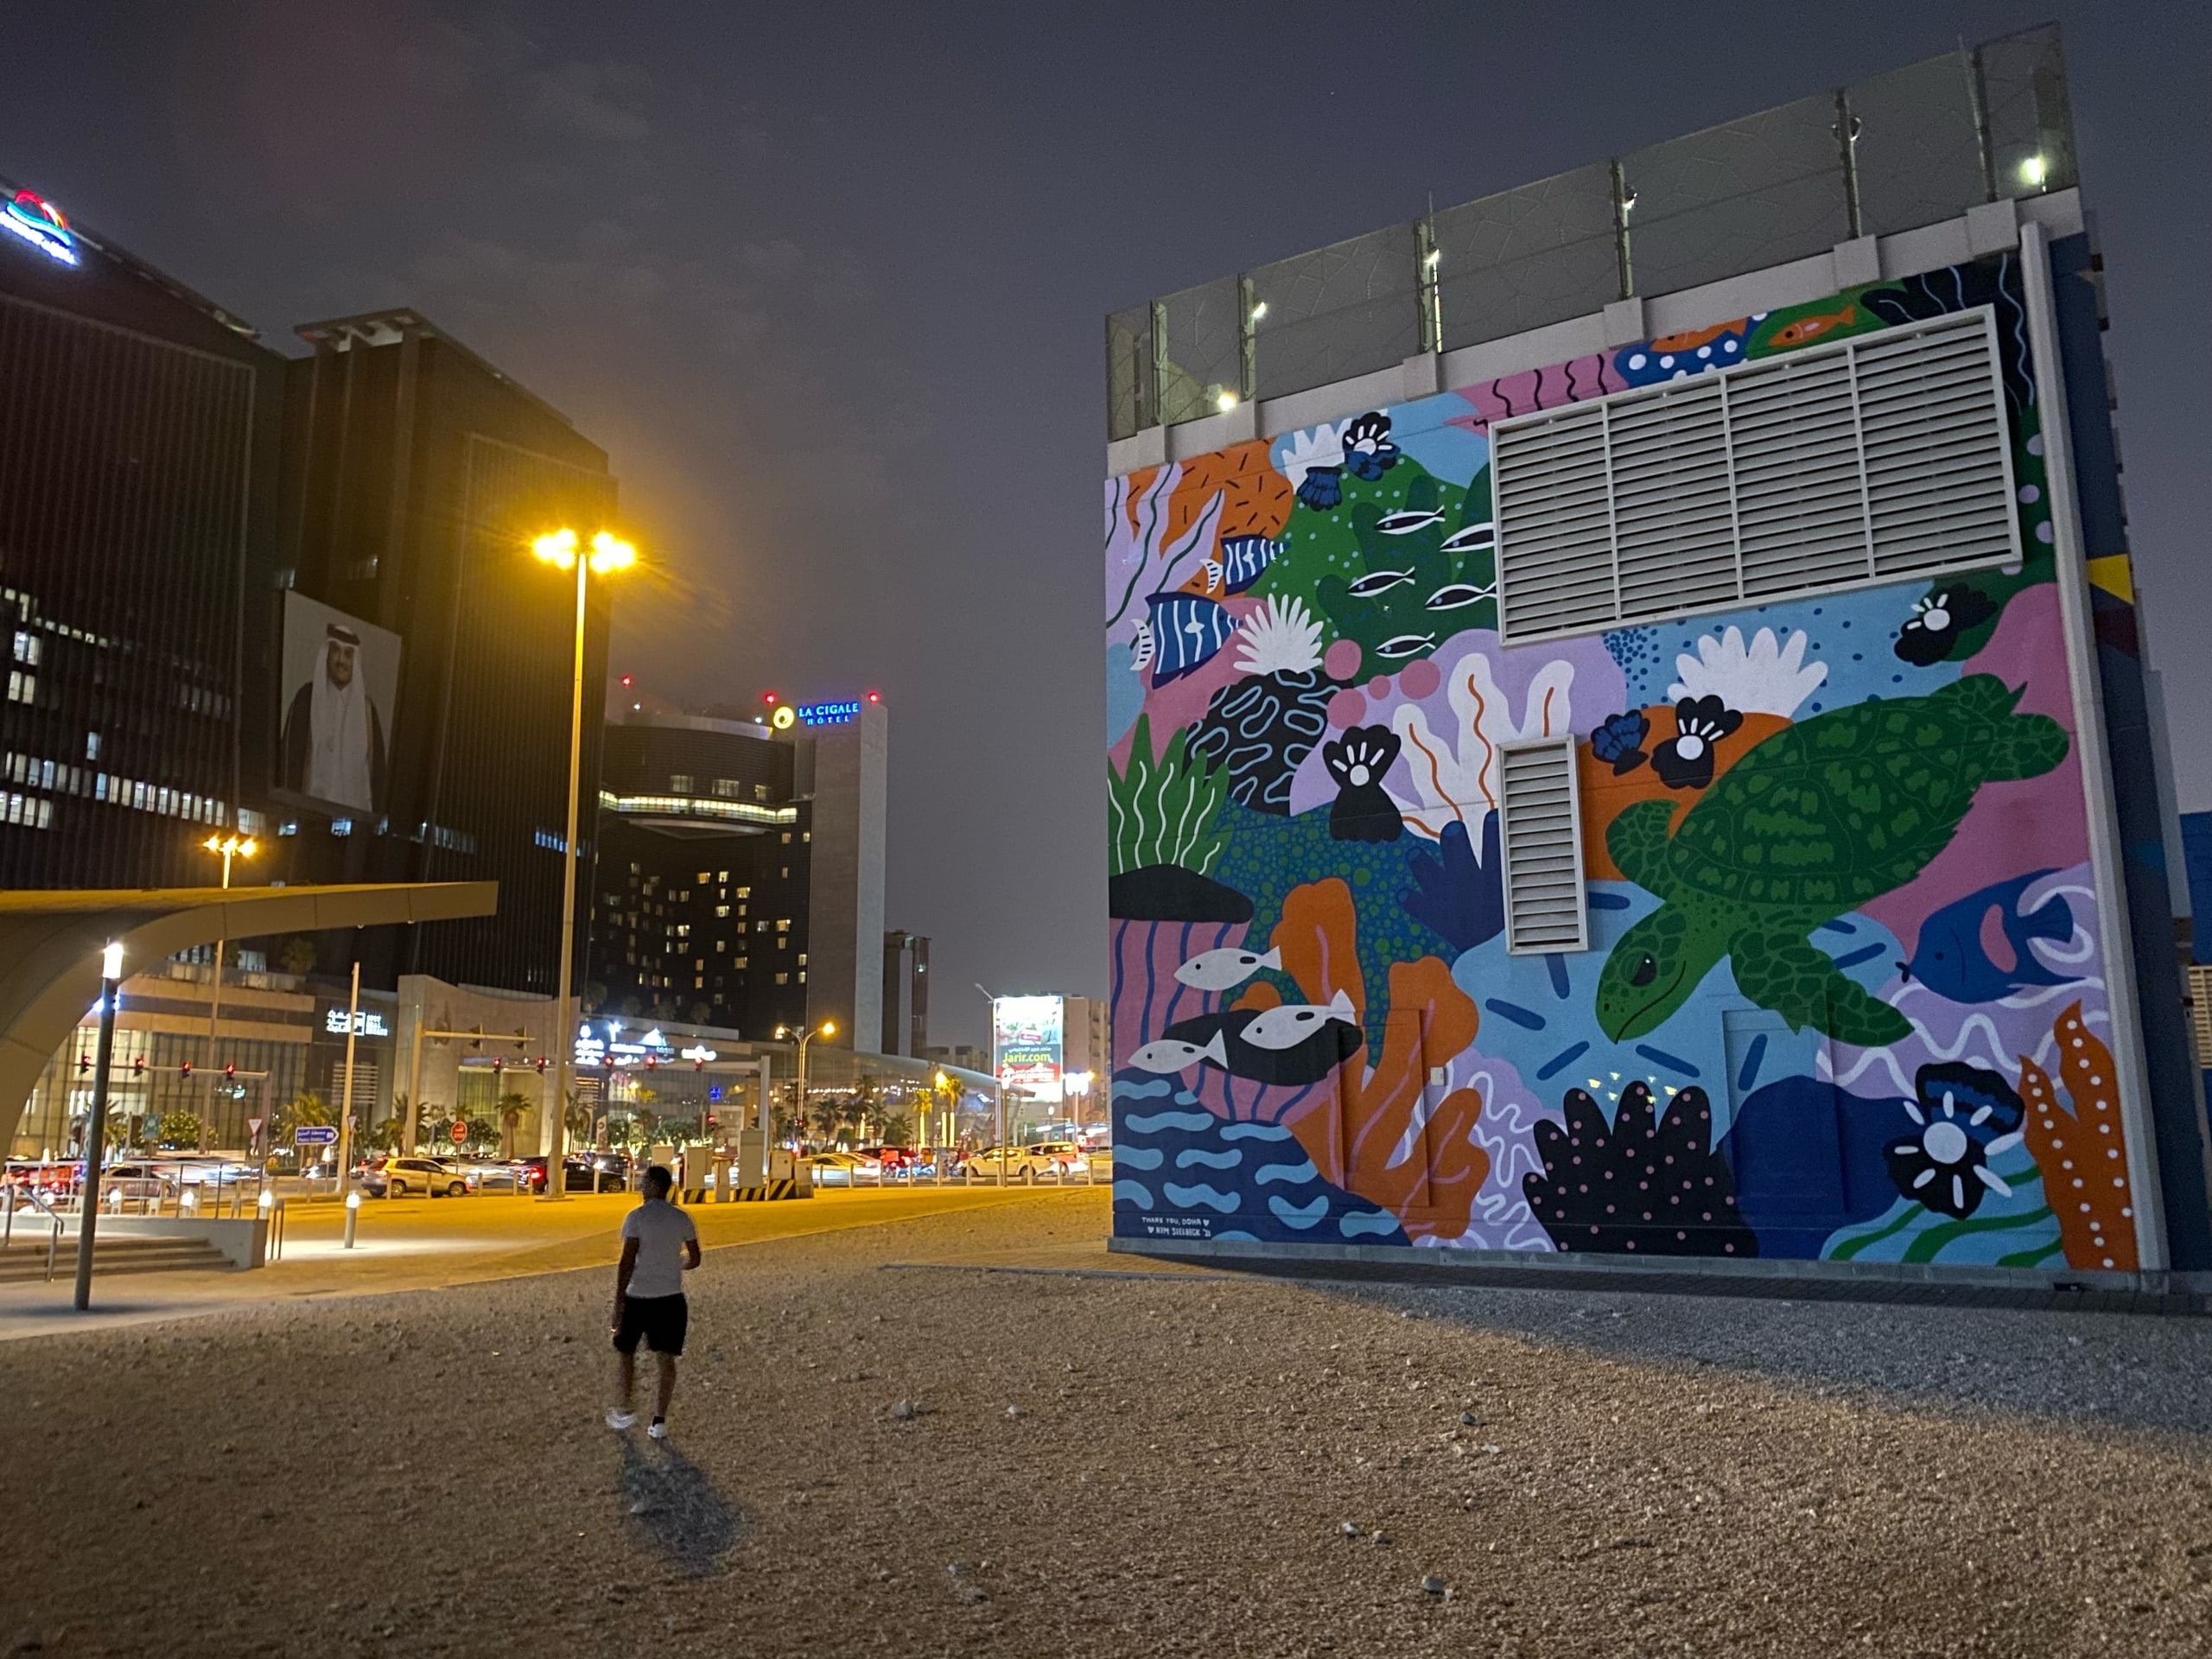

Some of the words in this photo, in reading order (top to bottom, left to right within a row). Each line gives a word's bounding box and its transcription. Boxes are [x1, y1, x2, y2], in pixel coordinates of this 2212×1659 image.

[798, 708, 812, 717] LA
[816, 702, 858, 715] CIGALE
[1002, 1052, 1050, 1063] Jarir.com
